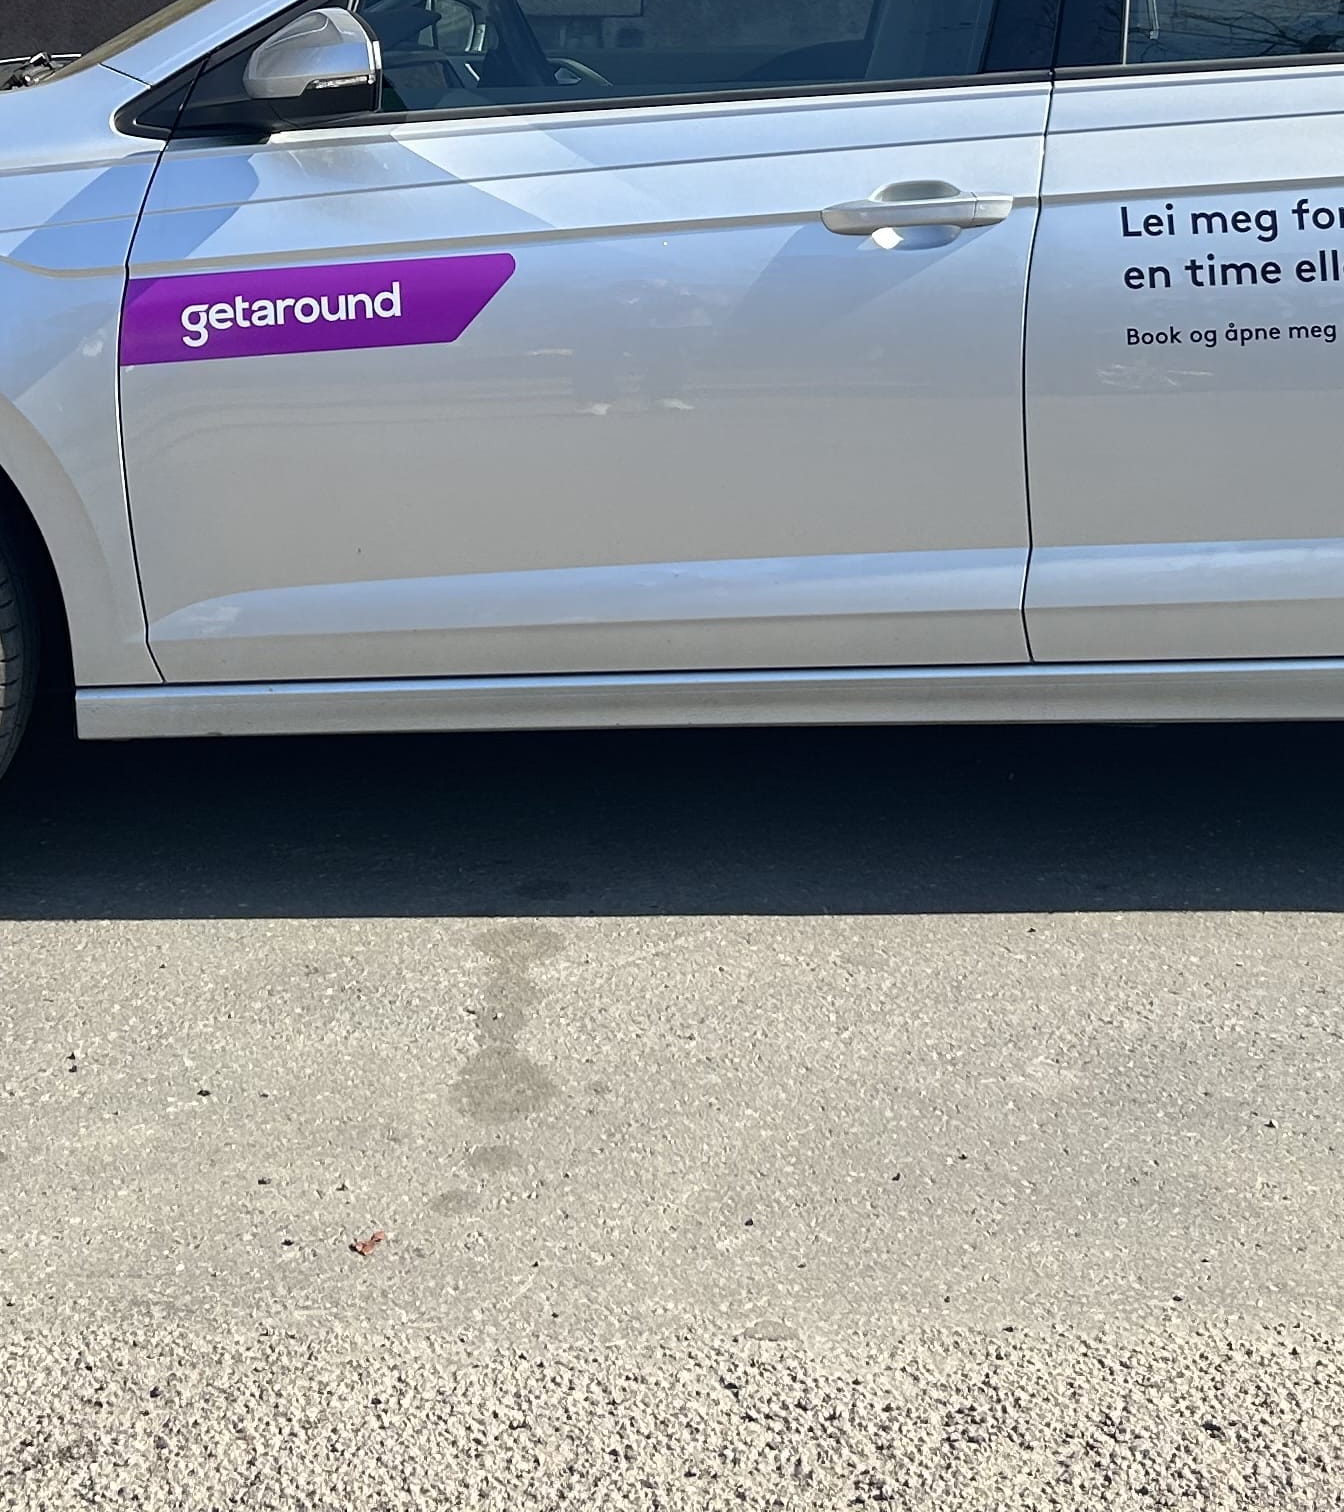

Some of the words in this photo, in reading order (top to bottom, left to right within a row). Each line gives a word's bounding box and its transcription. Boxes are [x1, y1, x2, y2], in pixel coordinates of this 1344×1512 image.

[1120, 202, 1176, 238] Lei
[1190, 206, 1279, 243] meg
[1123, 265, 1172, 290] en
[1184, 253, 1282, 287] time
[180, 281, 403, 348] getaround
[1126, 326, 1182, 346] Book
[1189, 329, 1218, 348] og
[1225, 321, 1281, 347] åpne
[1288, 322, 1338, 343] meg
